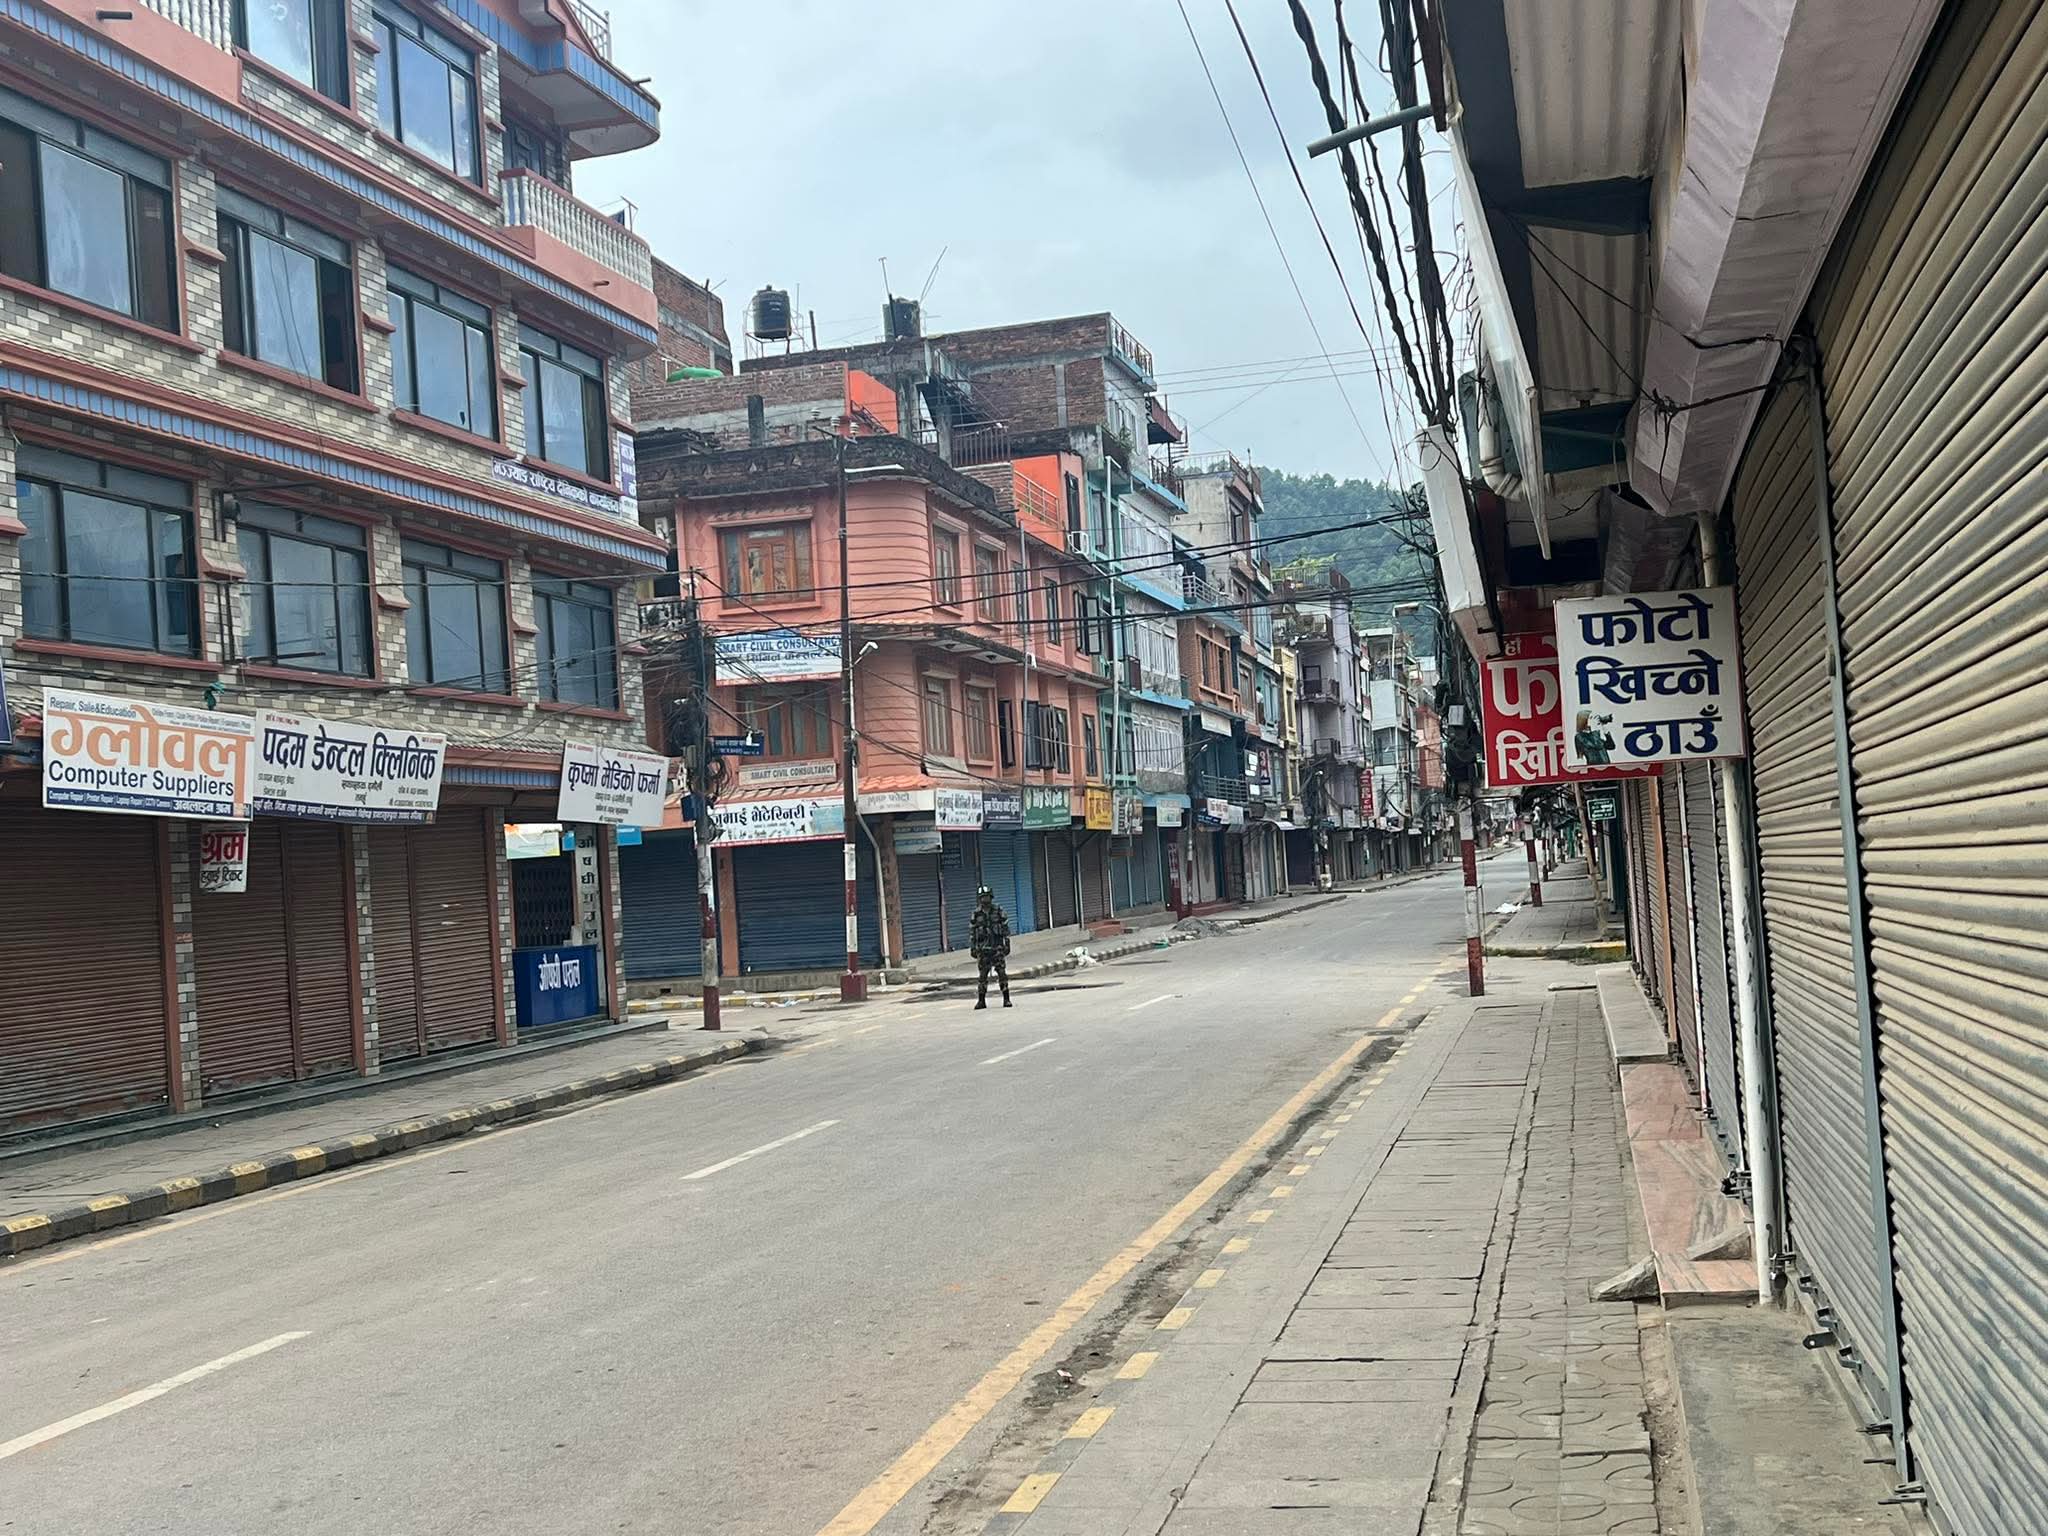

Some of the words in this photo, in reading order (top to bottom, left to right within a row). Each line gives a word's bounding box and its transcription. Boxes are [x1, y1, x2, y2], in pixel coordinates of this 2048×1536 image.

[1577, 593, 1713, 648] फोटो
[750, 642, 773, 652] CIVIL
[1575, 649, 1723, 705] खिच्ने
[263, 728, 308, 769] पदम
[313, 724, 367, 778] डेन्टल
[370, 732, 437, 780] क्लिनिक
[1622, 704, 1723, 758] ठाउँ
[47, 704, 255, 806] ग्लोवल
[601, 760, 635, 792] मेडिको
[751, 770, 771, 780] SMART
[773, 768, 788, 778] CIVIL
[790, 765, 834, 777] CONSULTANCY
[48, 760, 147, 789] Computer
[153, 770, 234, 797] Suppliers
[201, 832, 246, 865] श्रम
